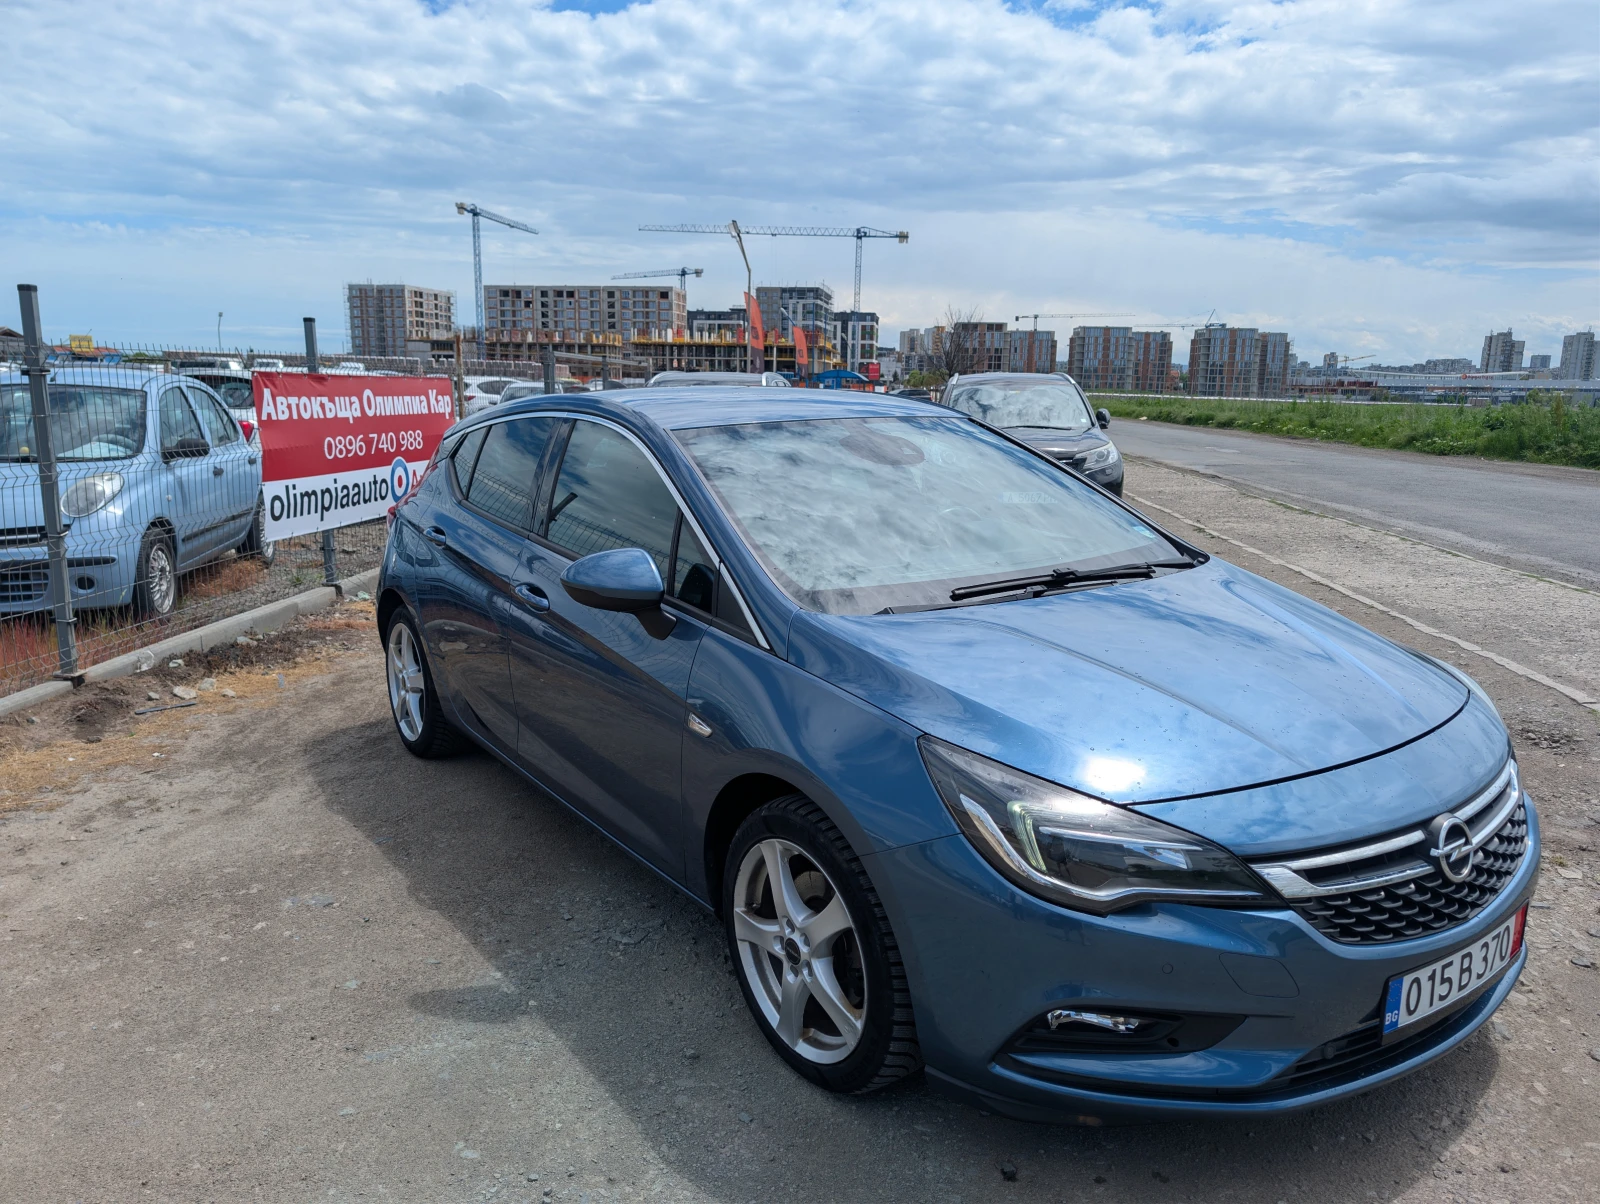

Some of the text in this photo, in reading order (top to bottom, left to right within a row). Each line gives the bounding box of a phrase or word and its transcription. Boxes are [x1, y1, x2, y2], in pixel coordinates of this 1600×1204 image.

[261, 388, 451, 423] Автокъща Олимпиа Кар
[324, 429, 423, 459] 0896 740 988
[270, 474, 389, 522] olimpiaauto
[1385, 1010, 1398, 1025] BG
